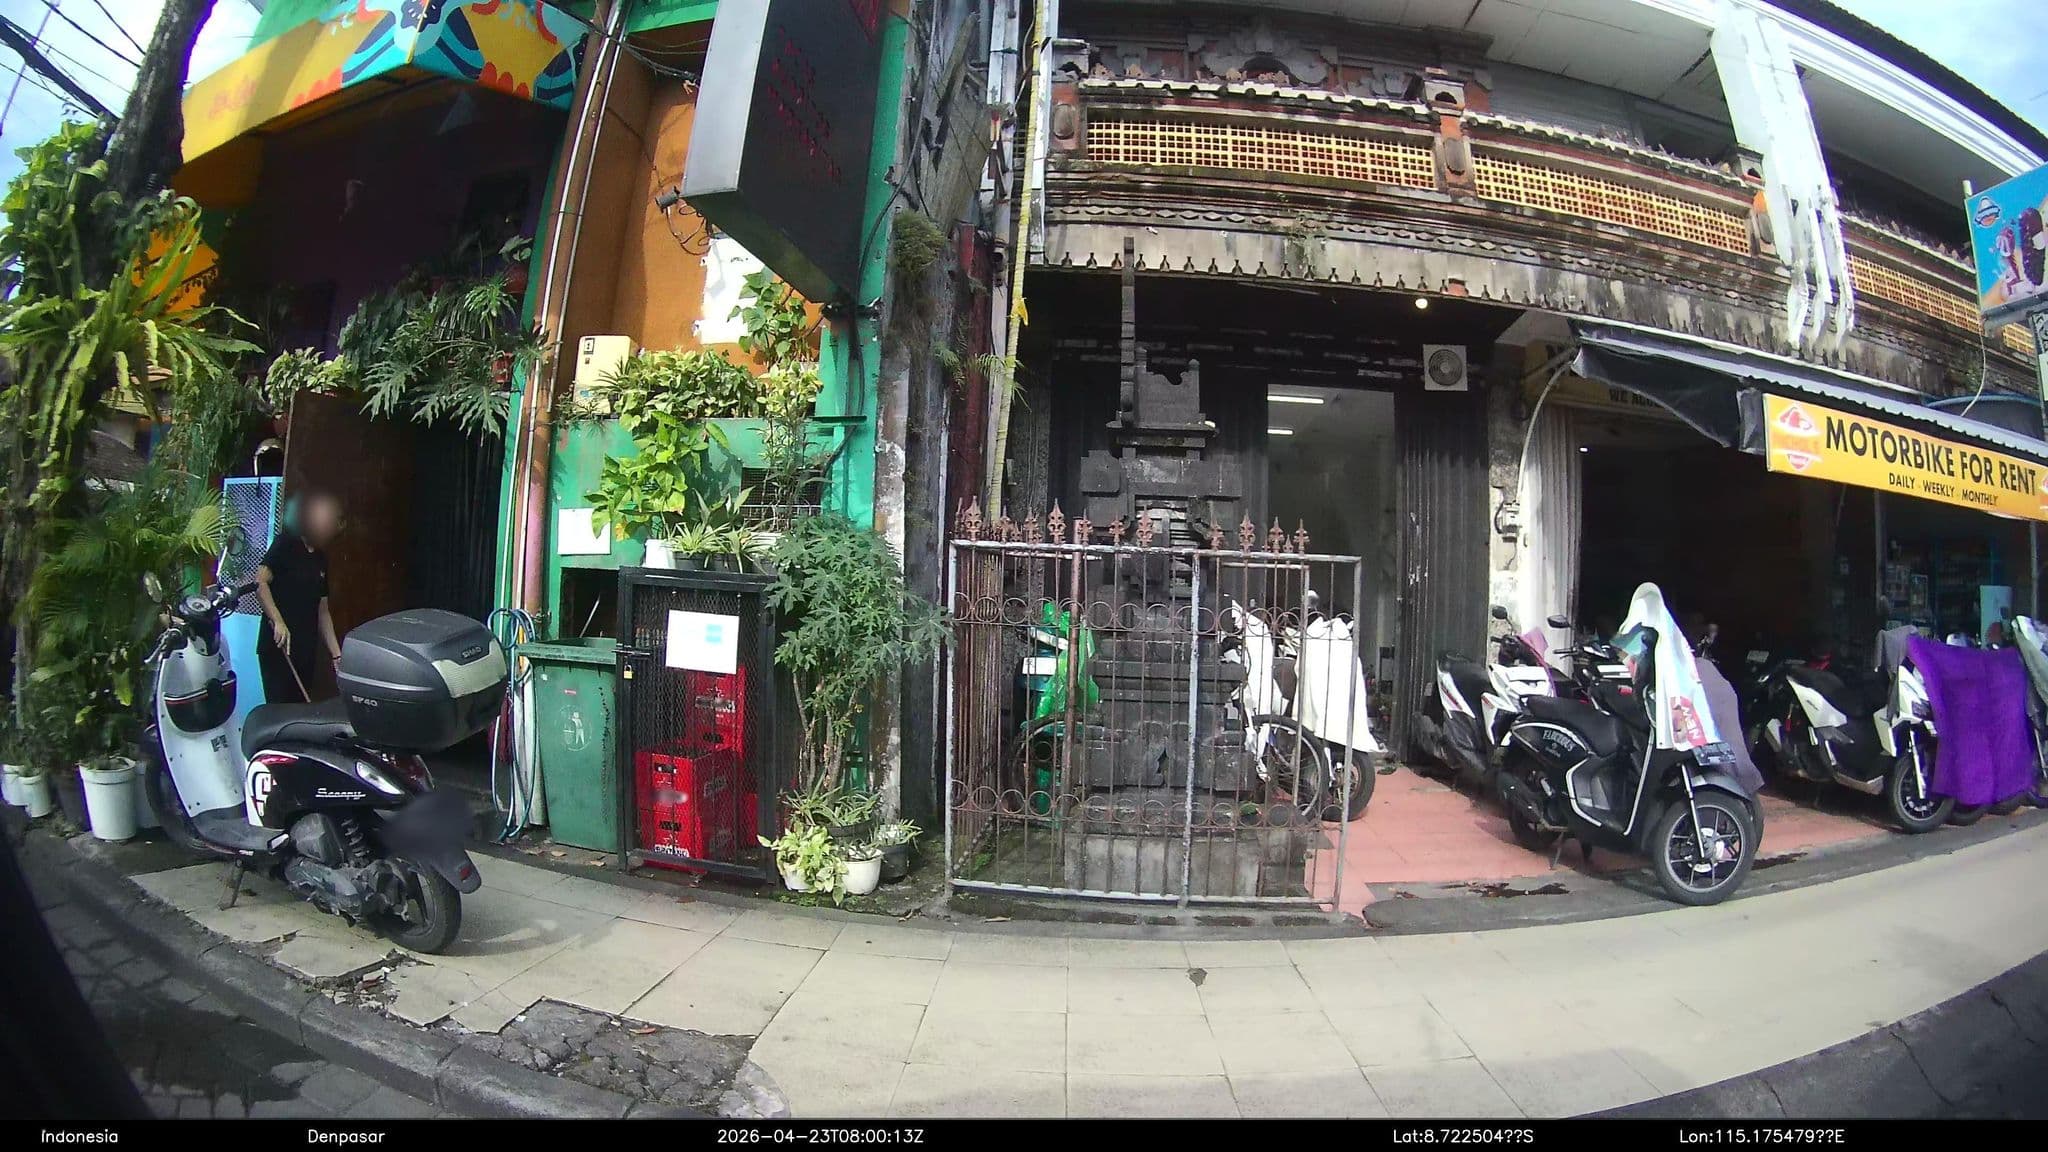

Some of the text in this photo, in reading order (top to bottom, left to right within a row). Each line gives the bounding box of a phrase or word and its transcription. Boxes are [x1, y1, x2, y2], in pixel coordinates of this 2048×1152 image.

[1825, 416, 1955, 477] MOTORBIKE
[1960, 451, 1994, 486] FOR
[2000, 461, 2036, 496] RENT
[1889, 472, 1999, 507] DAILY WEEKLY MONTHLY
[315, 788, 366, 800] Scoopy
